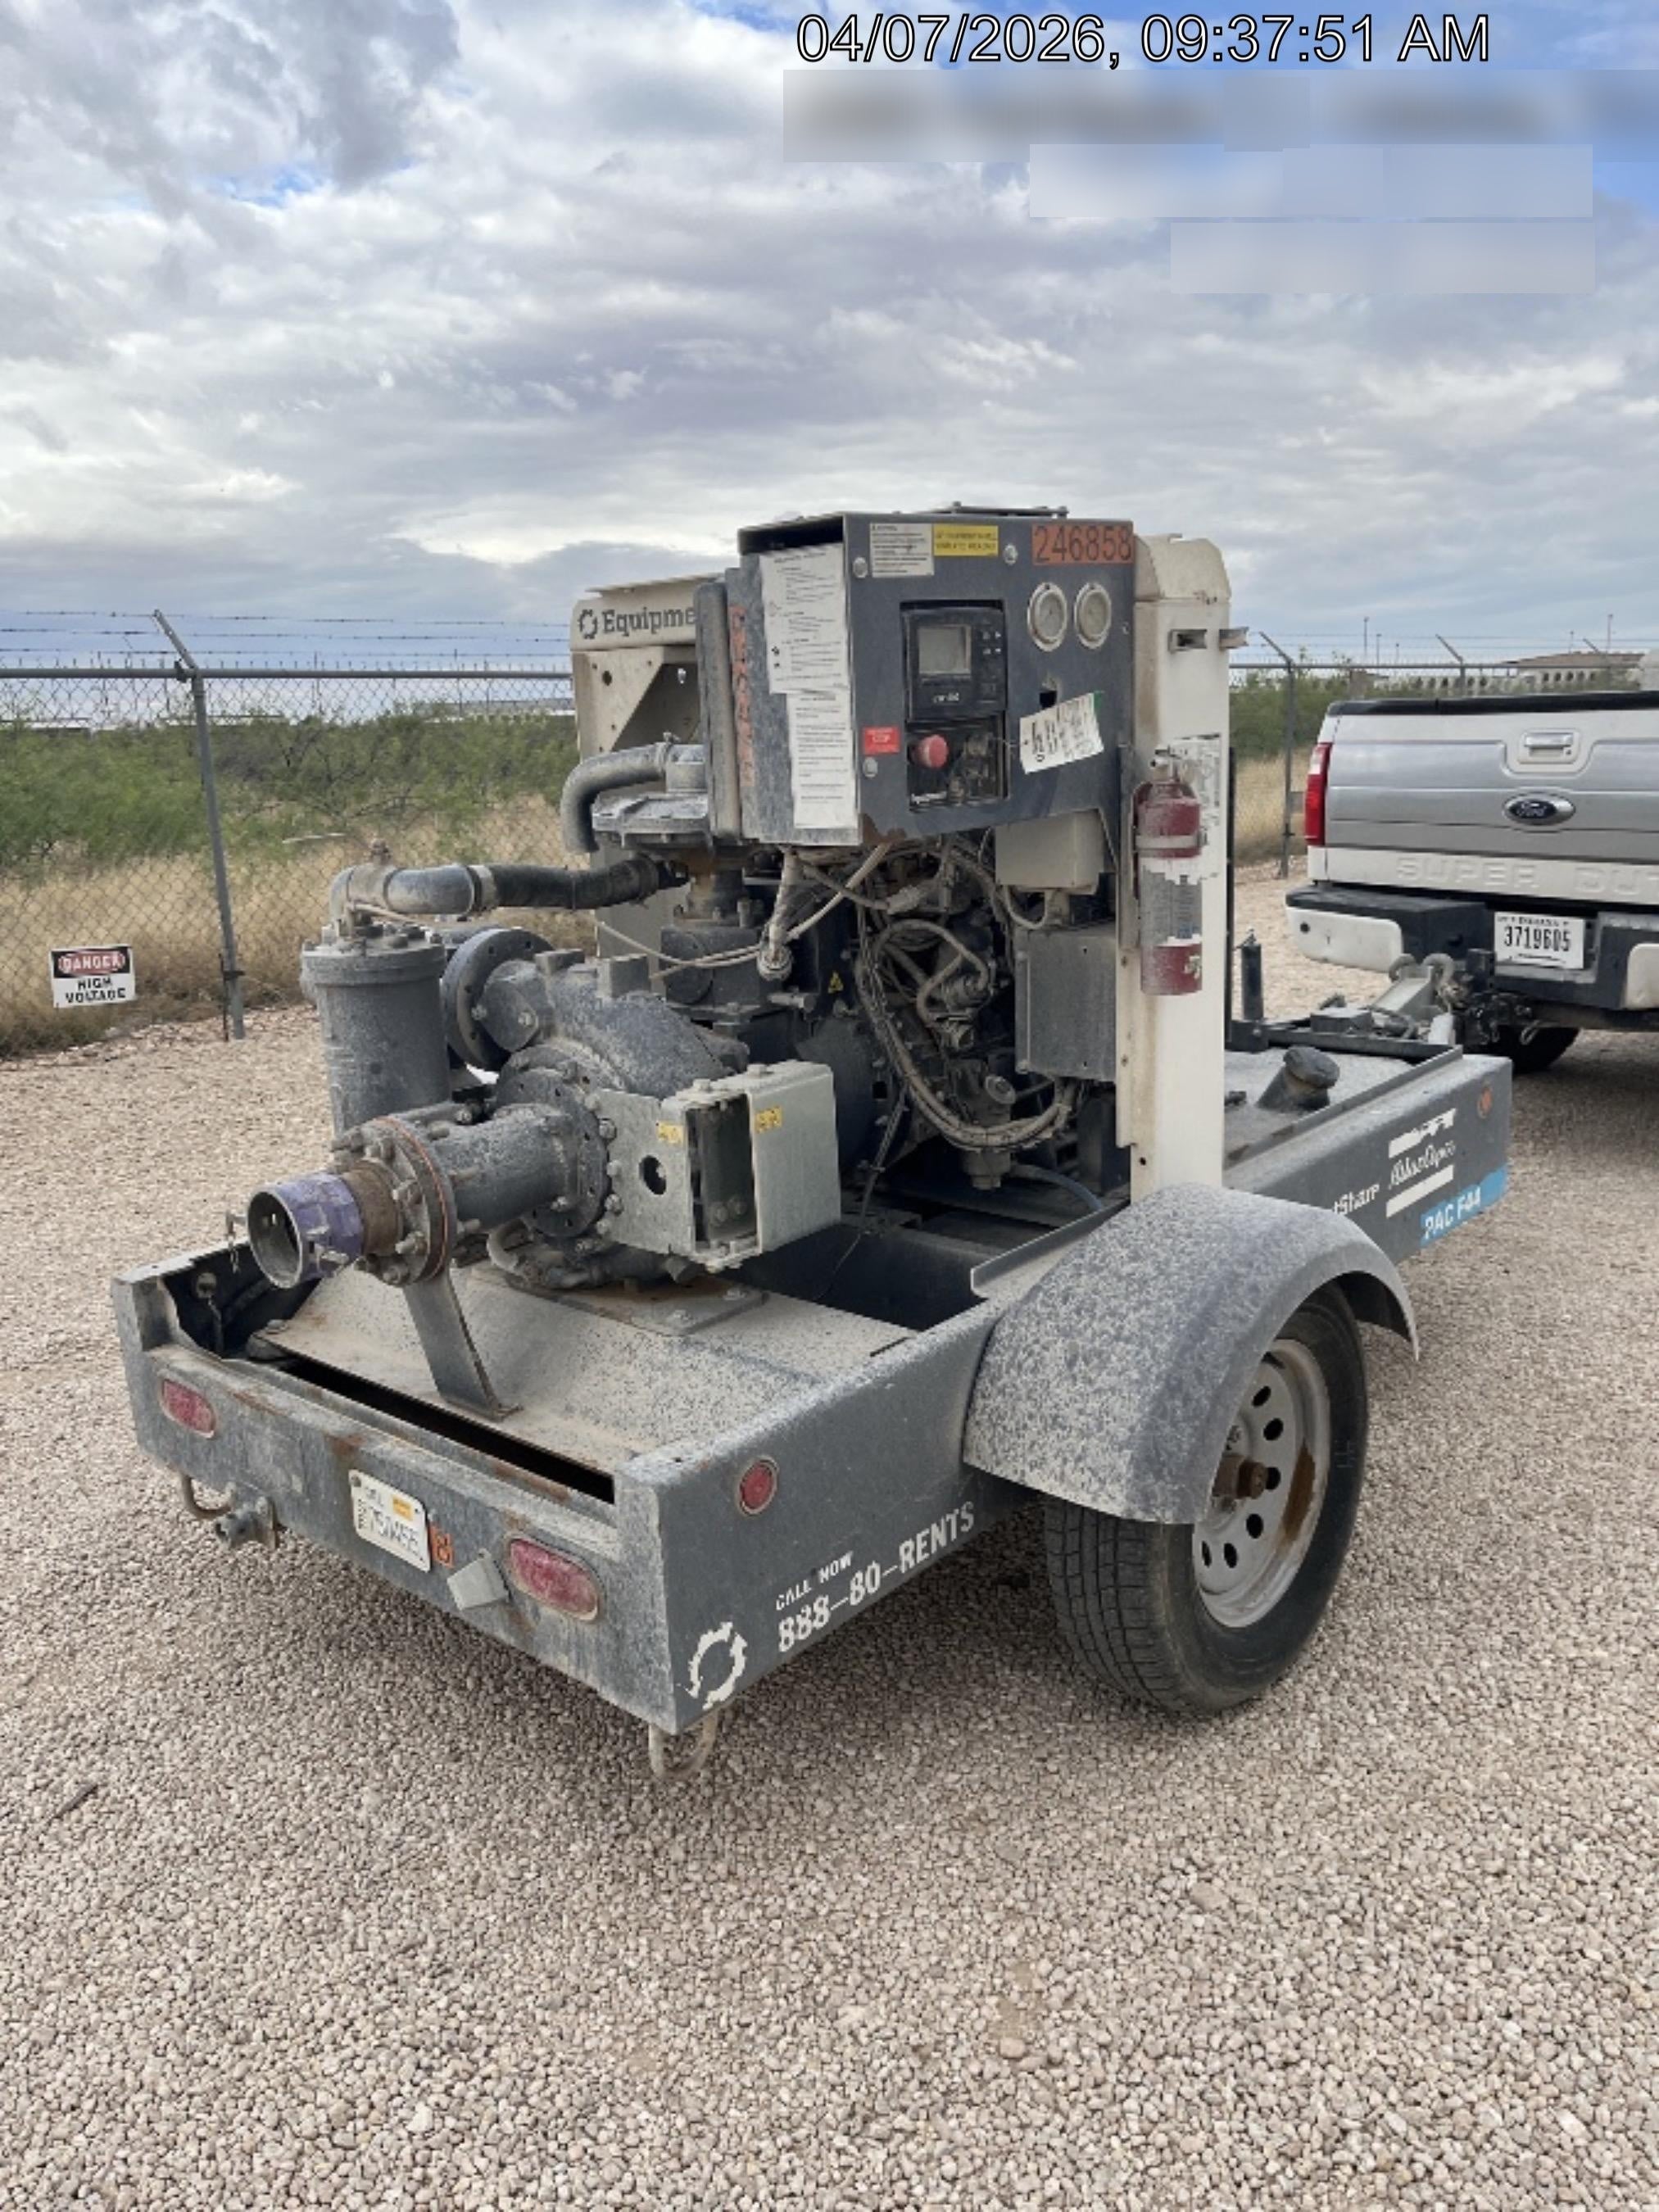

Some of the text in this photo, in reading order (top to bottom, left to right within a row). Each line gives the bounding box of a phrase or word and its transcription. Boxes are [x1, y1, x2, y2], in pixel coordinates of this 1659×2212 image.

[1035, 525, 1131, 561] 246858
[1395, 858, 1539, 889] SUPER
[1504, 925, 1571, 952] 3719605
[63, 954, 120, 971] DANGER
[66, 987, 126, 1003] VOLTAGE
[78, 977, 112, 990] HIGH
[1425, 1203, 1454, 1240] PAC
[776, 1550, 854, 1611] CALL NOW
